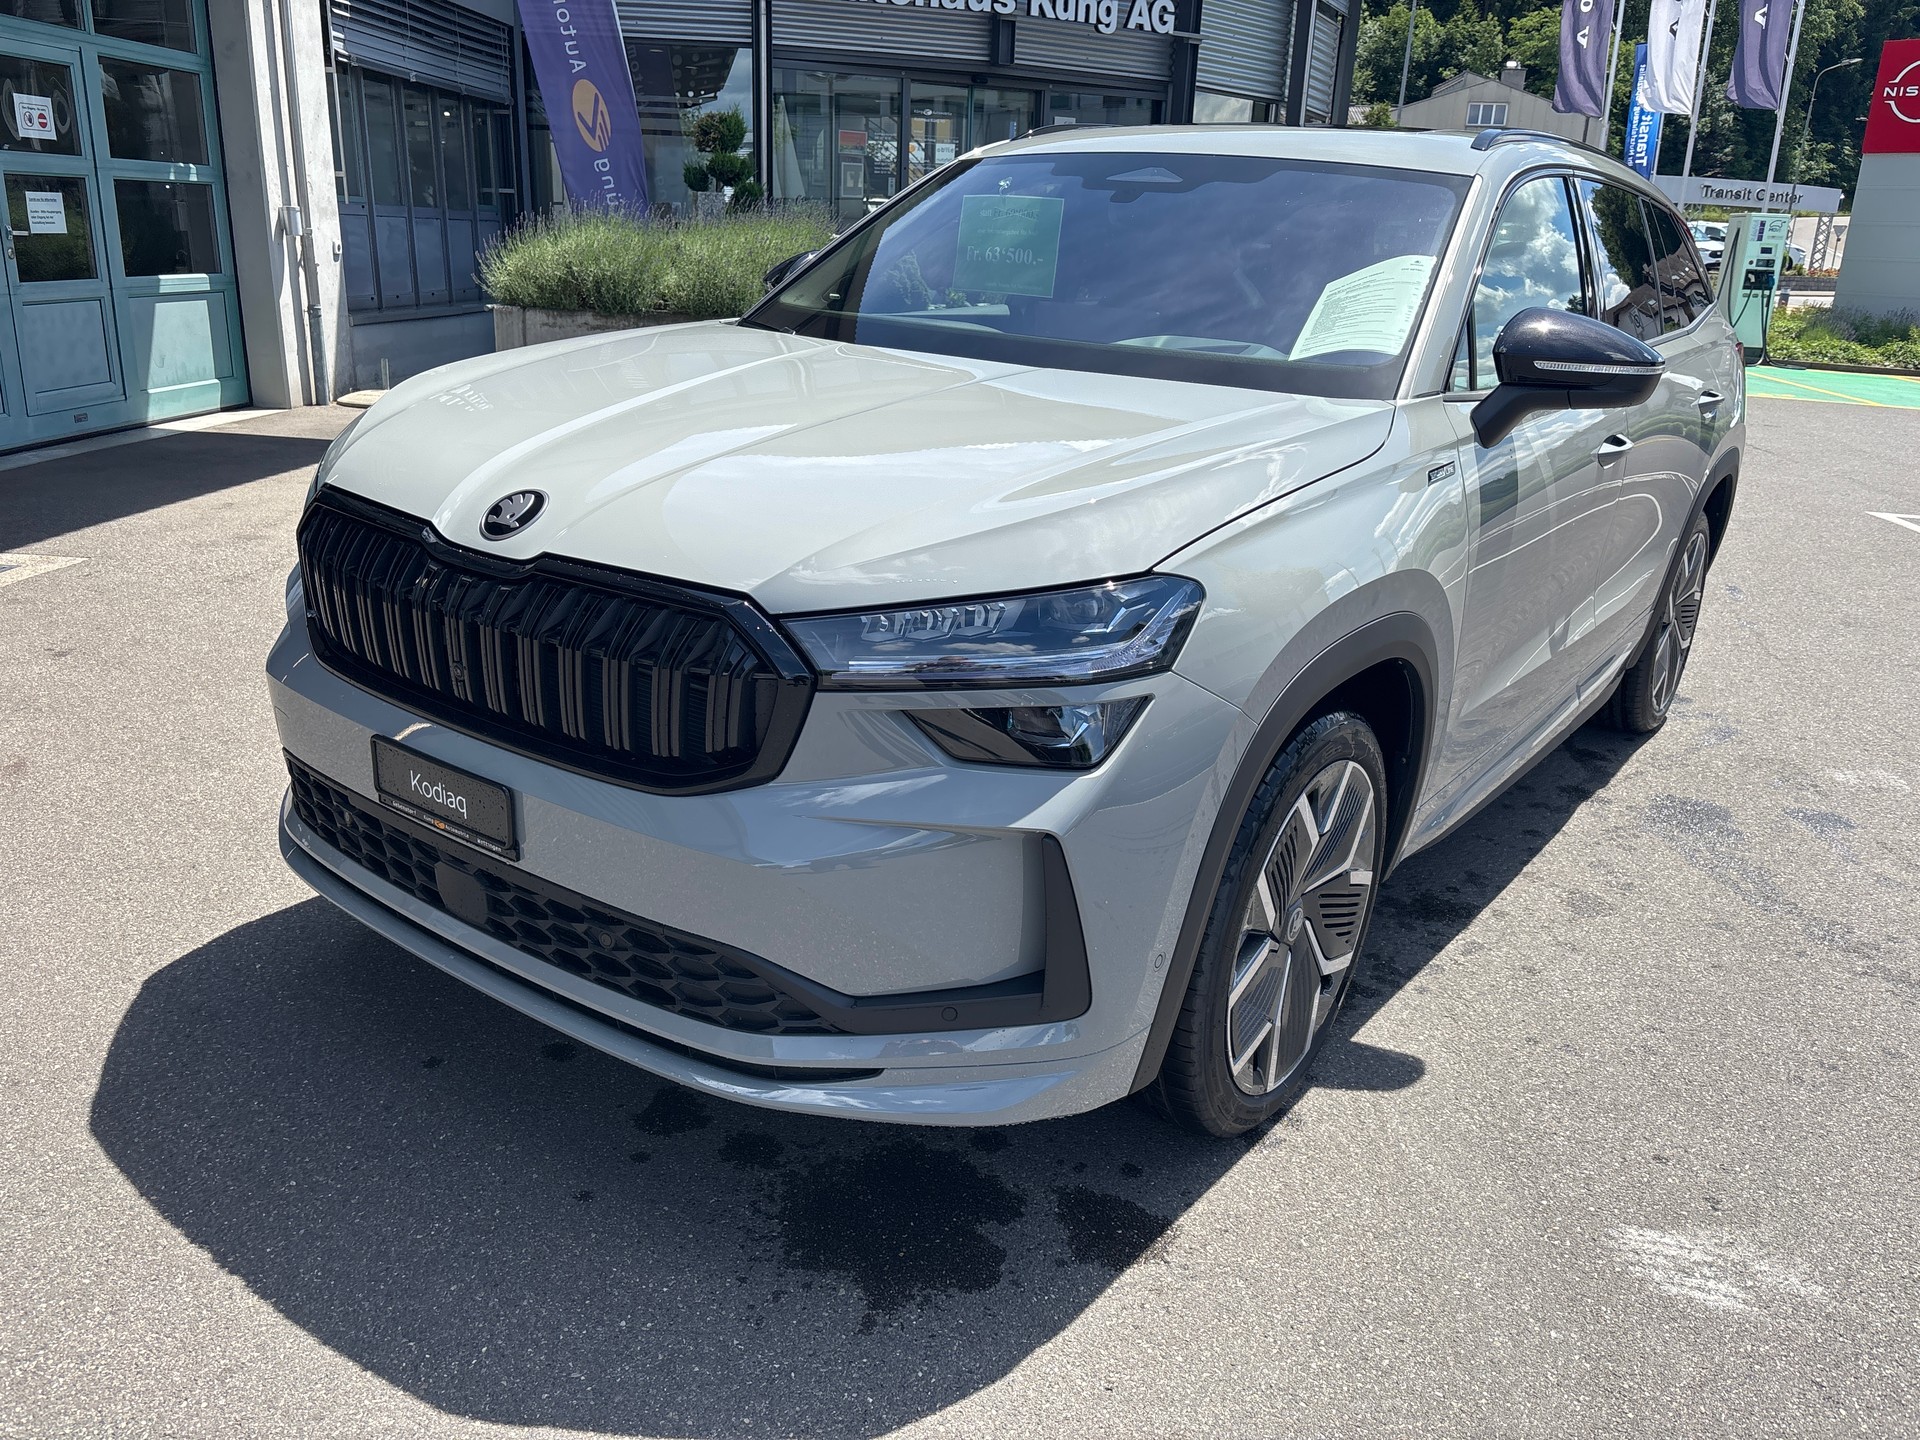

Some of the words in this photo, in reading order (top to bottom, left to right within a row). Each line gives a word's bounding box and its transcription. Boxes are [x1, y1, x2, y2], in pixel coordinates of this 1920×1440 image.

[1126, 0, 1176, 34] AG
[1702, 184, 1752, 201] Transit
[1756, 188, 1804, 204] Center
[967, 245, 982, 262] Fr.
[410, 770, 467, 820] Kodiaq
